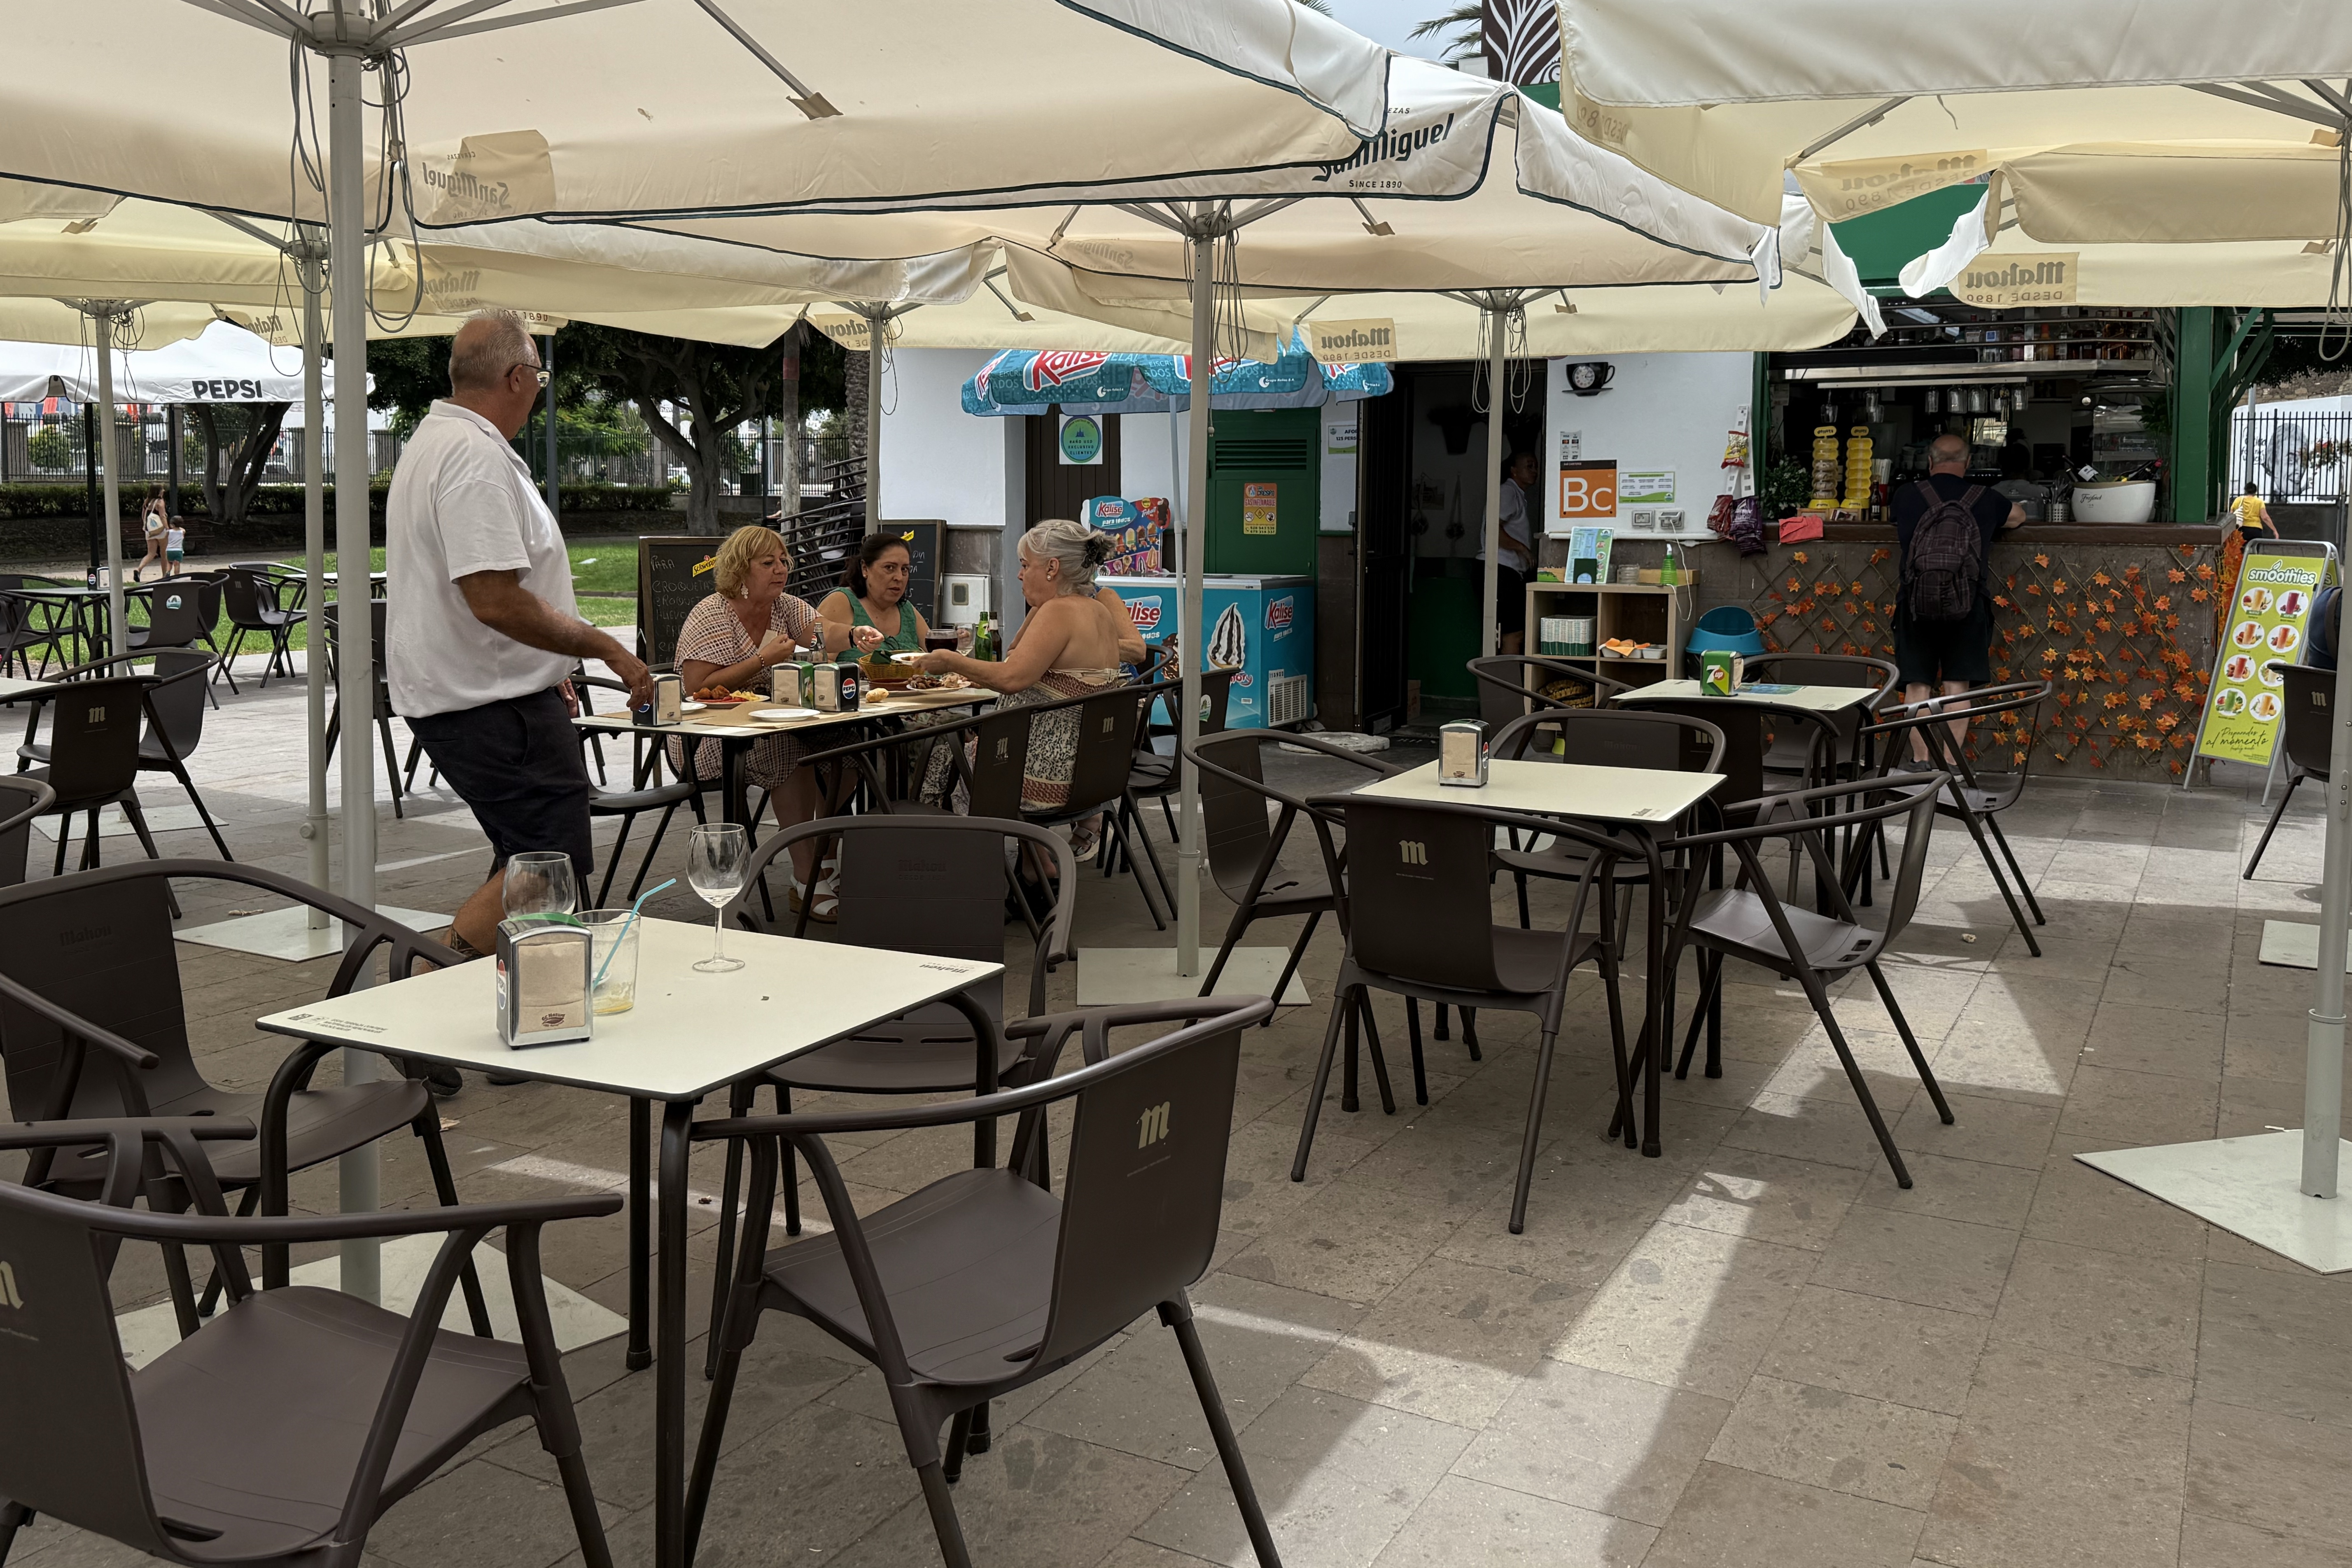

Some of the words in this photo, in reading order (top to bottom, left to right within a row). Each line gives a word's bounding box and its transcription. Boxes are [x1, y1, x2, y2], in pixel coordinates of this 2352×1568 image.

[1349, 180, 1377, 188] SINCE
[192, 379, 262, 399] PEPSI
[1563, 477, 1612, 512] Bc
[1098, 501, 1122, 517] Kalise
[2248, 568, 2316, 584] smoothies
[1268, 599, 1293, 629] Kalise
[2220, 730, 2268, 746] momento
